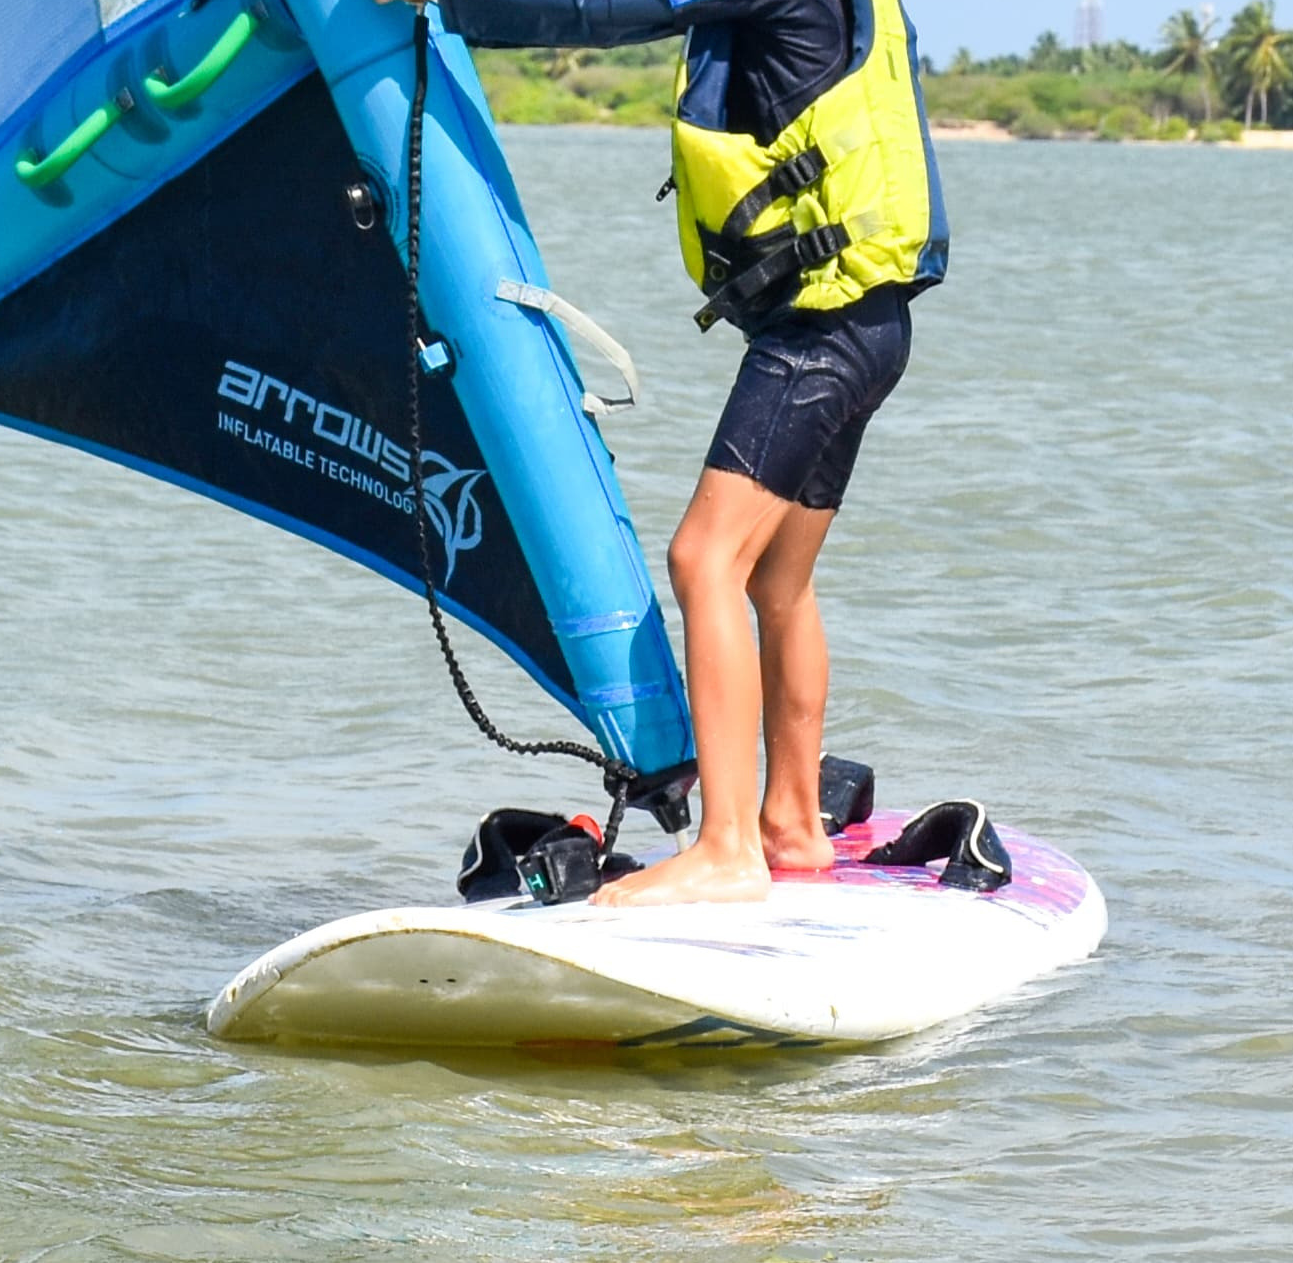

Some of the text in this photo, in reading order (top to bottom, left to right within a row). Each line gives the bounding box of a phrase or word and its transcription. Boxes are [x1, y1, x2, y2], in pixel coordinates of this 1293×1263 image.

[217, 360, 411, 482] arrows
[218, 411, 417, 514] INFLATABLE TECHNOLOG
